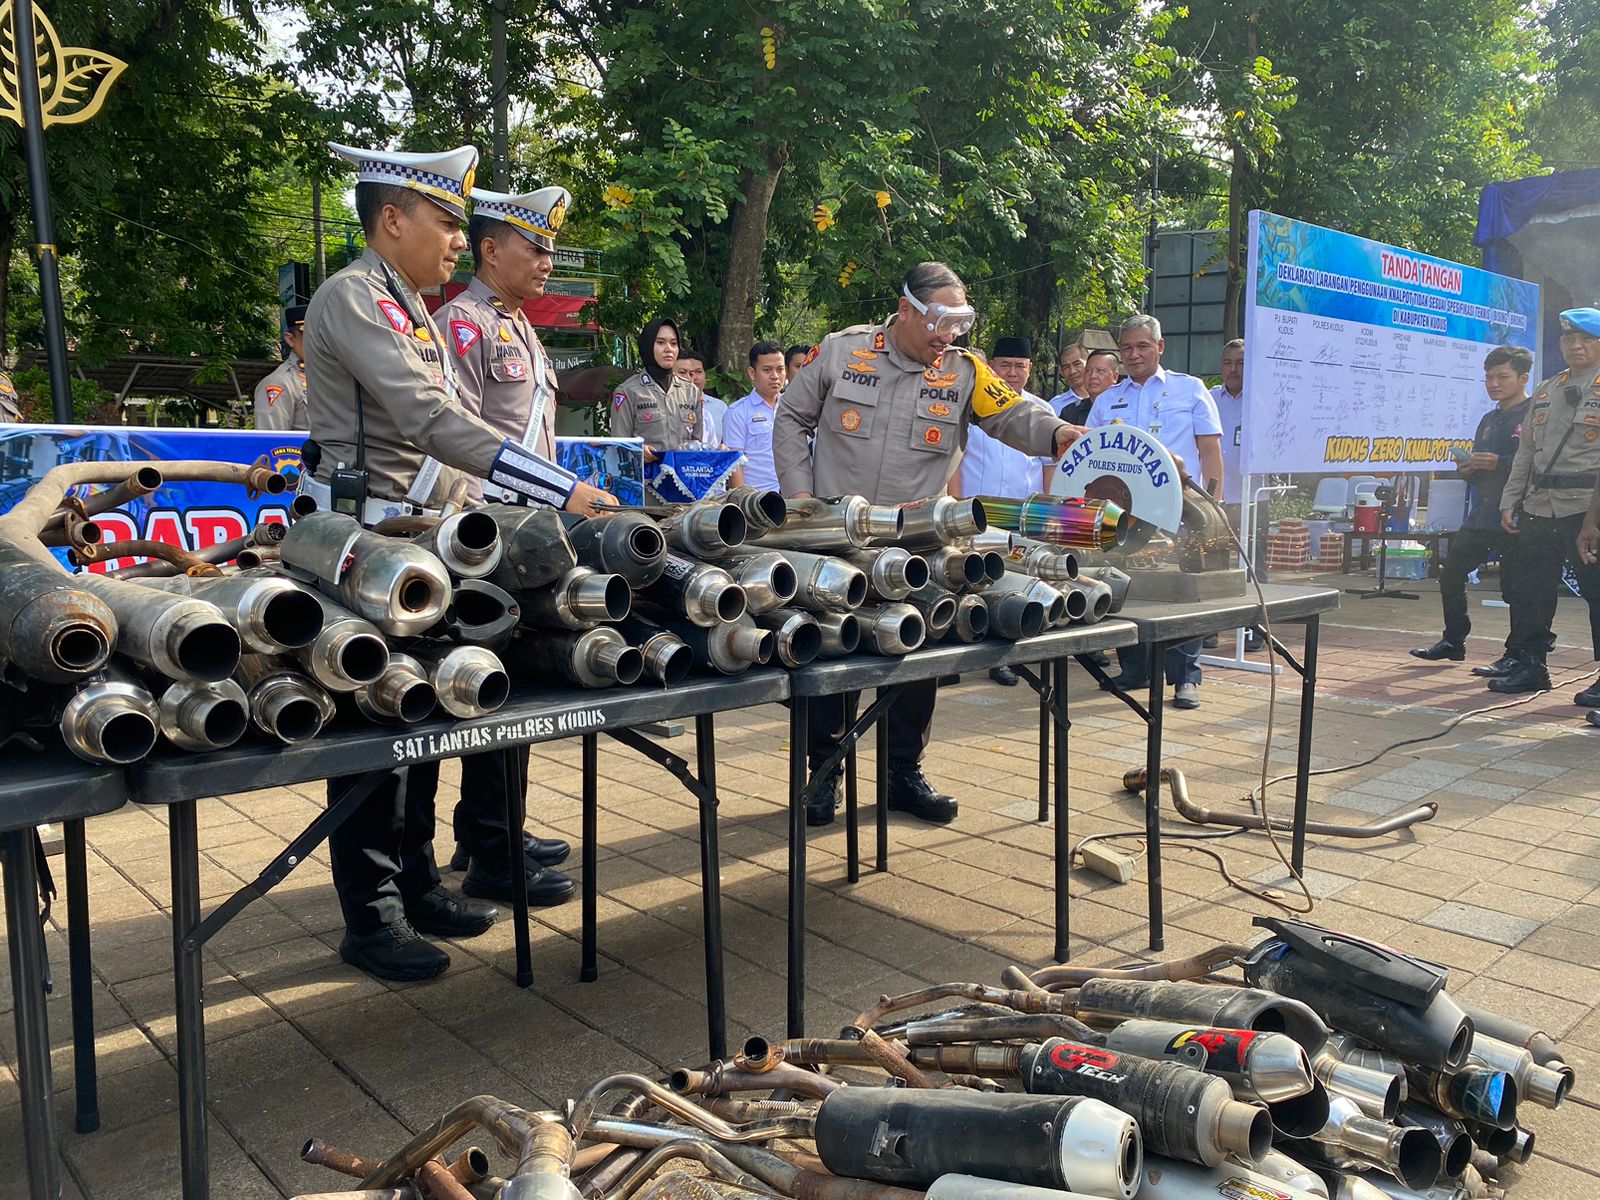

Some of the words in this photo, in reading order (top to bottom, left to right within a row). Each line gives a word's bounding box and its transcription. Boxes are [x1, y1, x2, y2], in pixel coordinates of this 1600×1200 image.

[1278, 264, 1314, 286] DEKLARASI
[1316, 272, 1348, 292] LARANGAN
[1382, 254, 1418, 281] TANDA
[1421, 264, 1462, 291] TANGAN
[1400, 311, 1429, 327] KABUPATEN
[842, 370, 880, 387] DYDIT
[920, 388, 960, 402] POLRI
[1061, 438, 1093, 477] SAT
[1099, 432, 1170, 488] LANTAS
[1324, 436, 1369, 463] KUDUS
[1369, 437, 1403, 463] ZERO
[1403, 438, 1451, 464] KNALPOT
[1088, 459, 1116, 472] POLRES
[1117, 463, 1143, 474] KUDUS
[393, 734, 423, 761] SAT
[429, 726, 492, 755] LANTAS
[497, 717, 554, 740] POLRES
[558, 709, 606, 731] KUDUS
